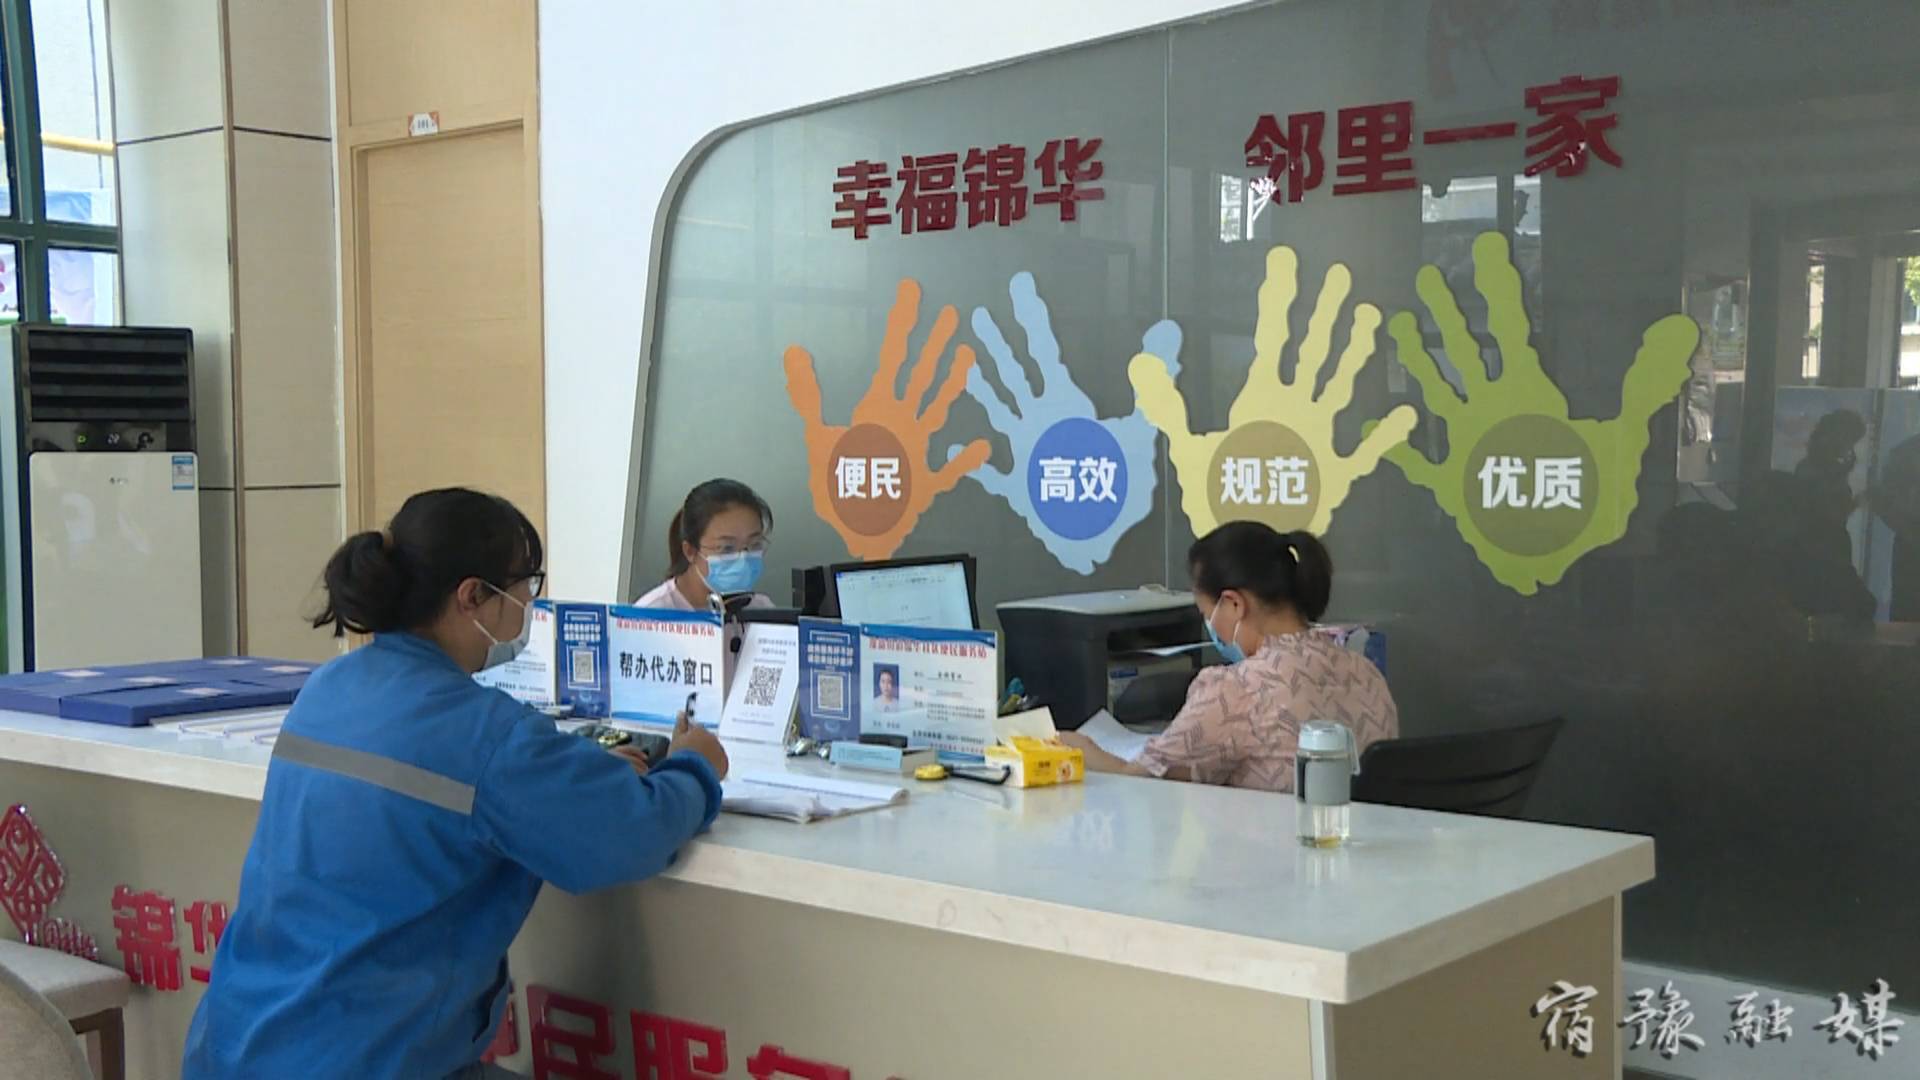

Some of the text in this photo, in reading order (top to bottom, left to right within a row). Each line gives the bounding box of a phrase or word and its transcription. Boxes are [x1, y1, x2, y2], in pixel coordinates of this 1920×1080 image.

[1244, 76, 1622, 206] 邻里一家
[832, 136, 1104, 239] 幸福锦华
[834, 456, 902, 500] 便民
[1039, 456, 1118, 503] 高效
[1220, 457, 1309, 506] 规范
[1477, 457, 1583, 511] 优质
[619, 651, 714, 686] 帮办代办窗口
